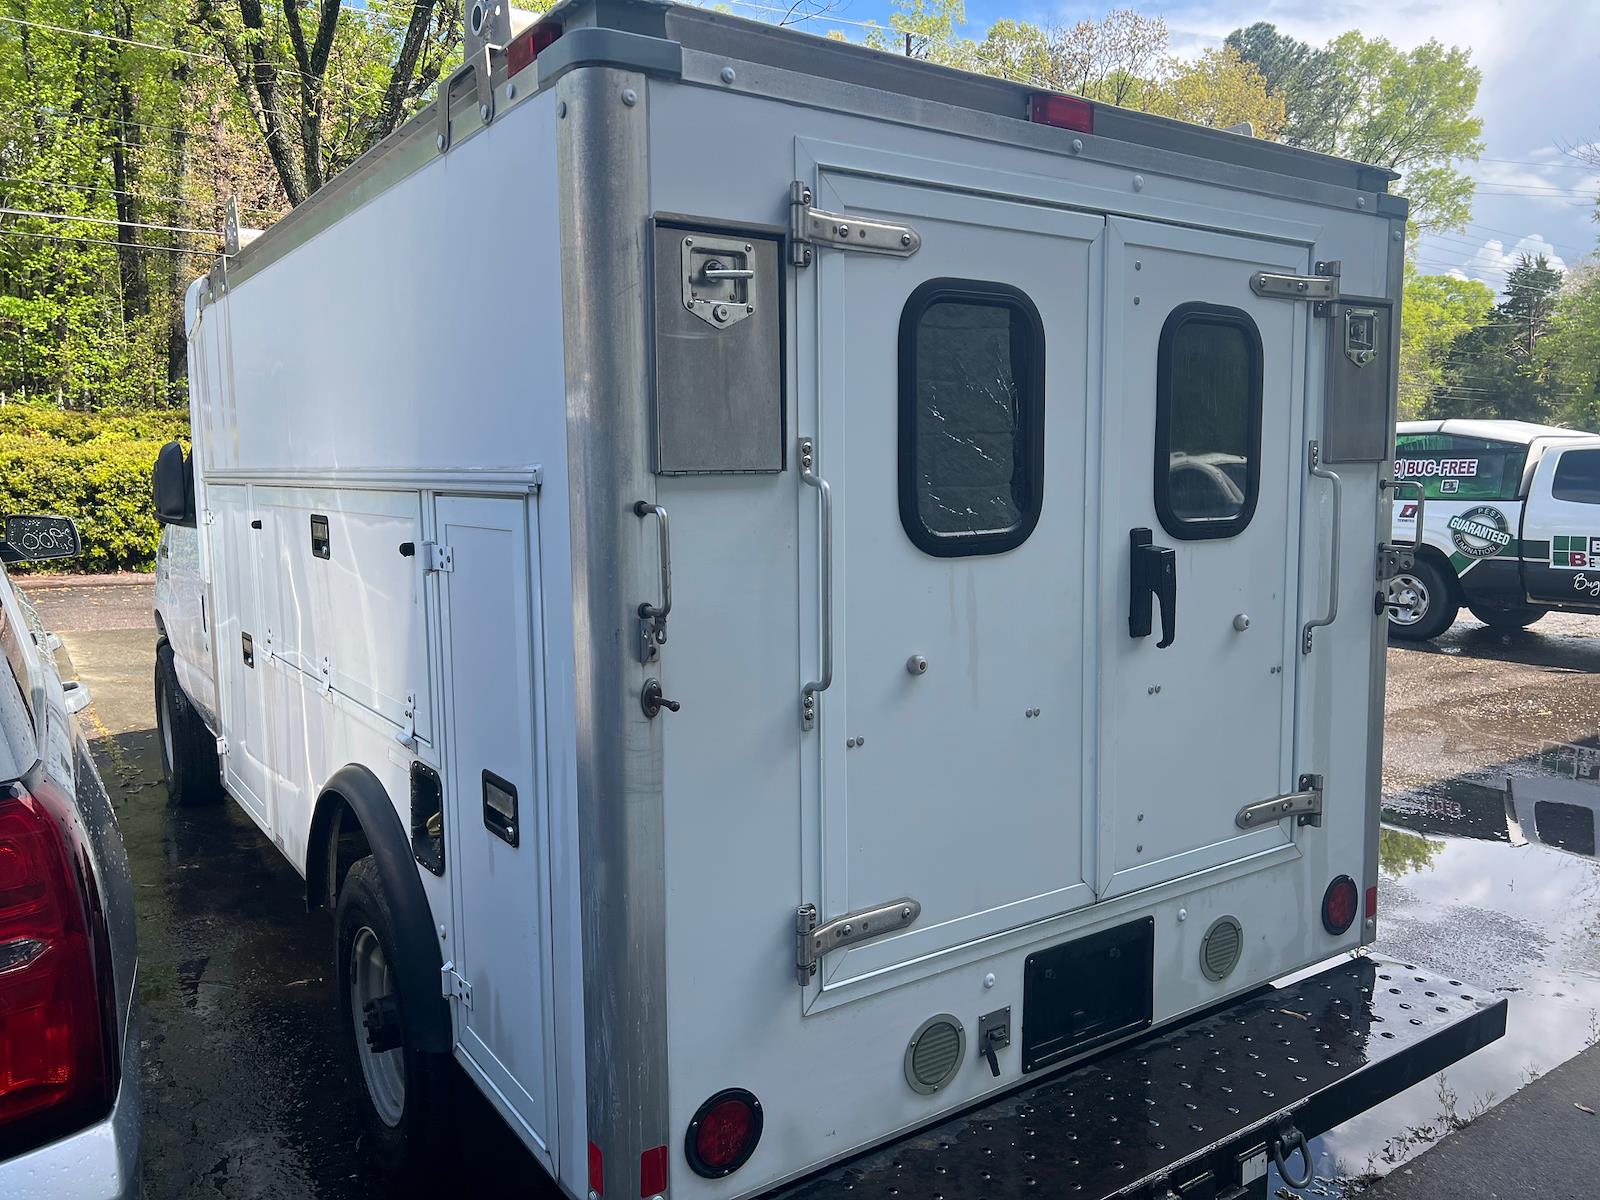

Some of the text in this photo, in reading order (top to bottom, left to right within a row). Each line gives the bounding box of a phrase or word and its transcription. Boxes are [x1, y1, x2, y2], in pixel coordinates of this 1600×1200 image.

[1477, 507, 1502, 520] PEST
[1450, 517, 1510, 546] GUARANTEED
[1454, 533, 1496, 556] ELIMINATION
